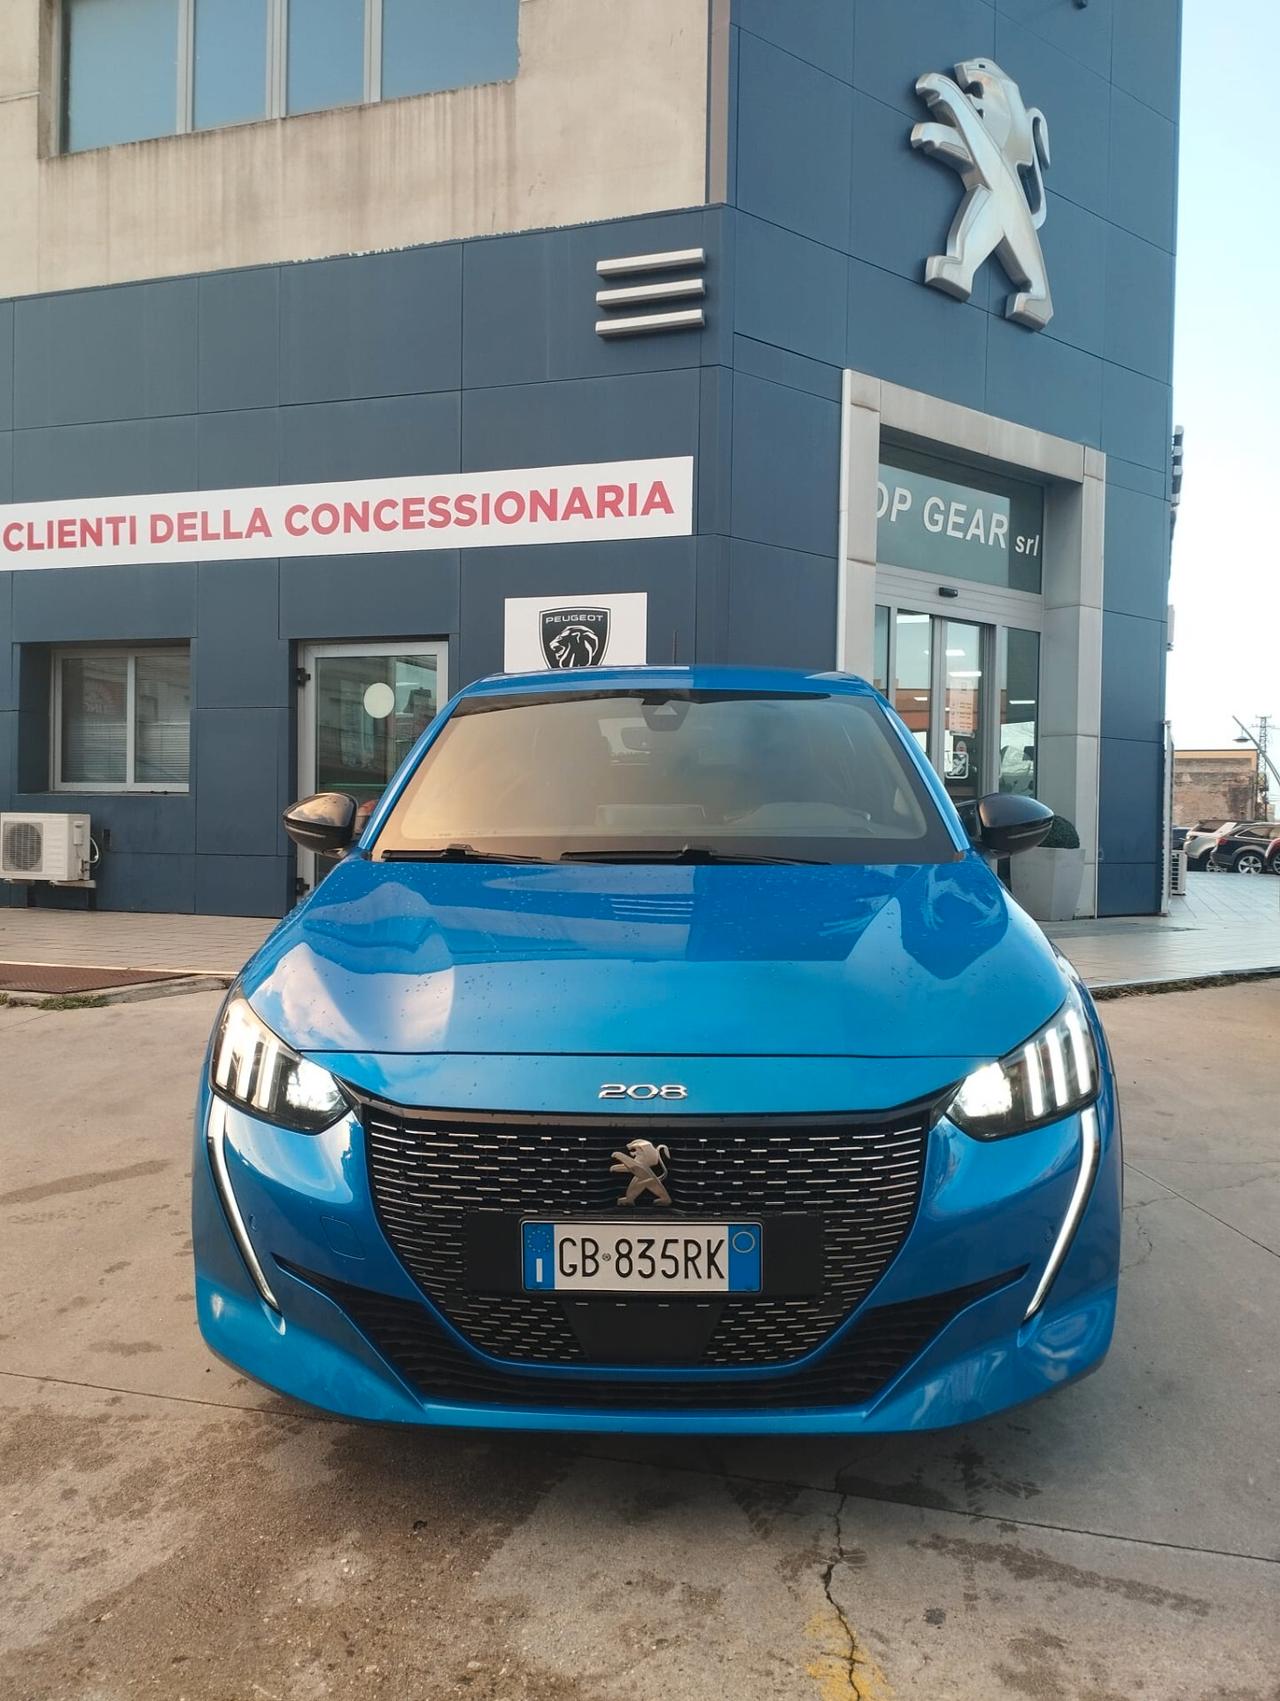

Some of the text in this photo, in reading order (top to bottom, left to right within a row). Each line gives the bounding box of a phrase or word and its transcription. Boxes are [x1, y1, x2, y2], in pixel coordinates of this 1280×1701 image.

[3, 480, 675, 553] CLIENTI DELLA CONCESSIONARIA
[923, 496, 1008, 549] GEAR
[1015, 534, 1040, 556] srl
[545, 614, 604, 624] PEUGEOT
[598, 1083, 689, 1100] 208
